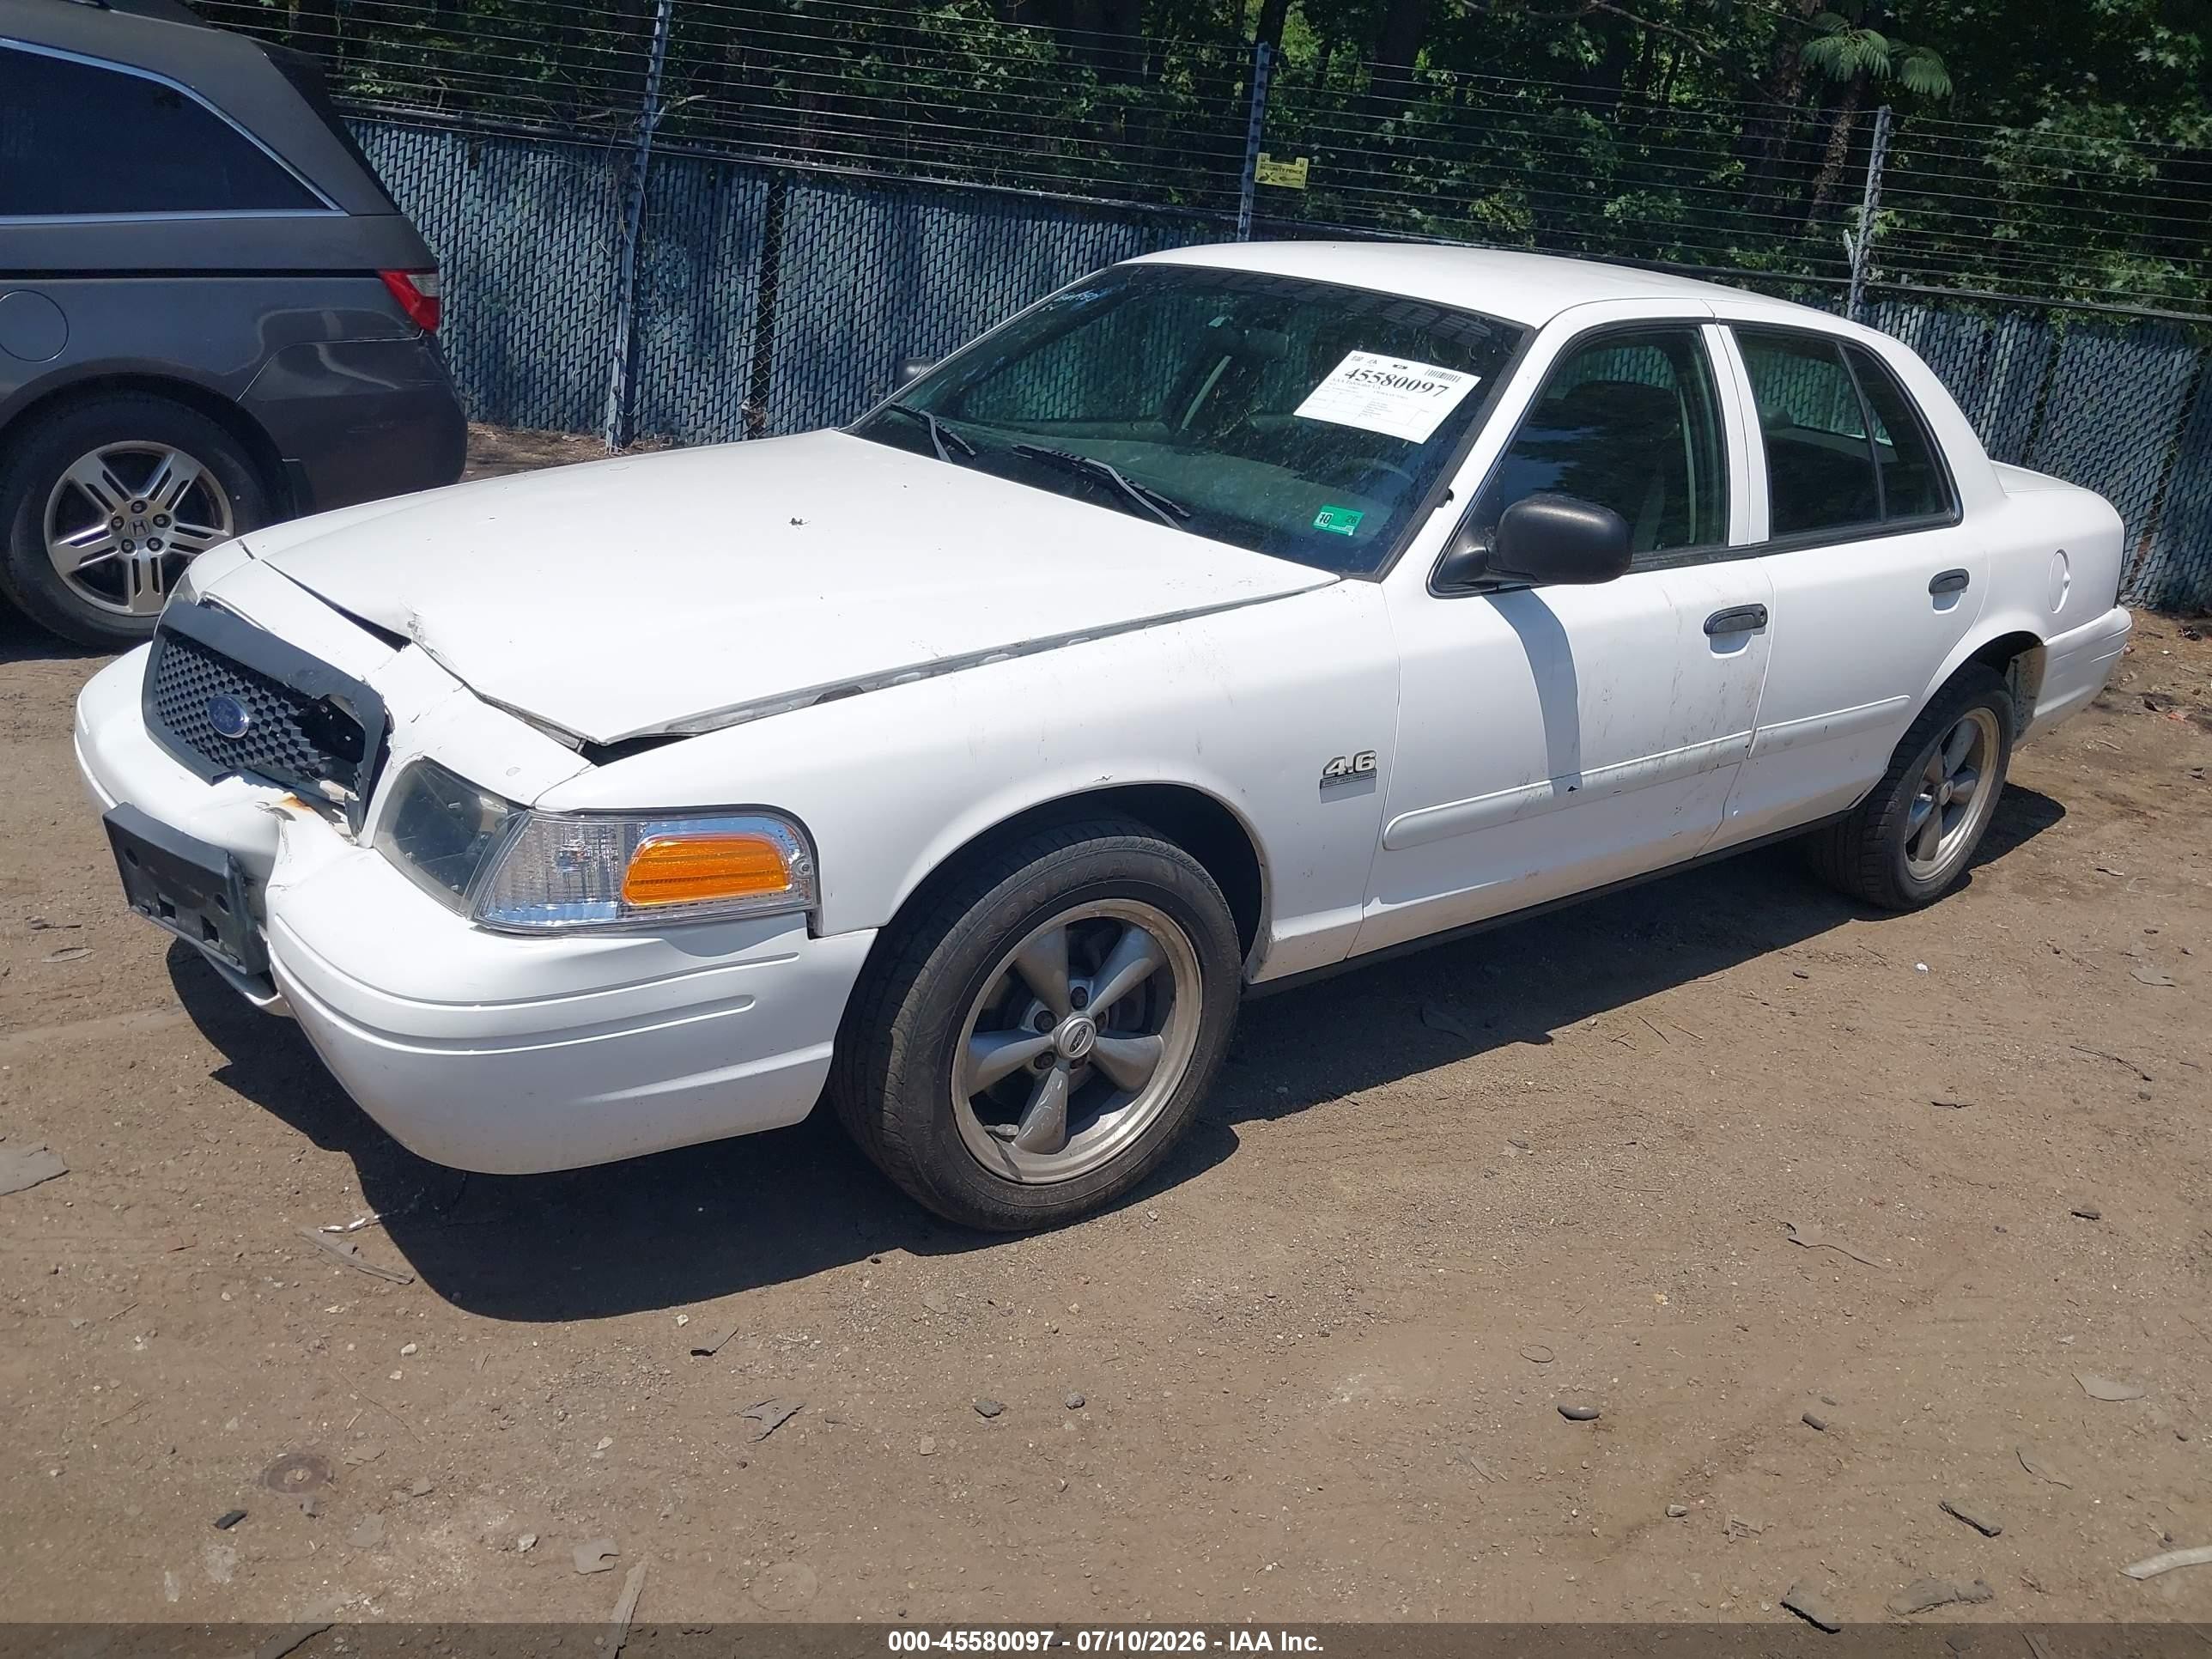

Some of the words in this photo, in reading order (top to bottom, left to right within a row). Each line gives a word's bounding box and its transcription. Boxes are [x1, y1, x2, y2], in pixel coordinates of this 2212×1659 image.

[1345, 368, 1451, 398] 45580097
[1319, 514, 1332, 524] 10
[1346, 514, 1358, 525] 26
[1323, 750, 1376, 776] 4.6
